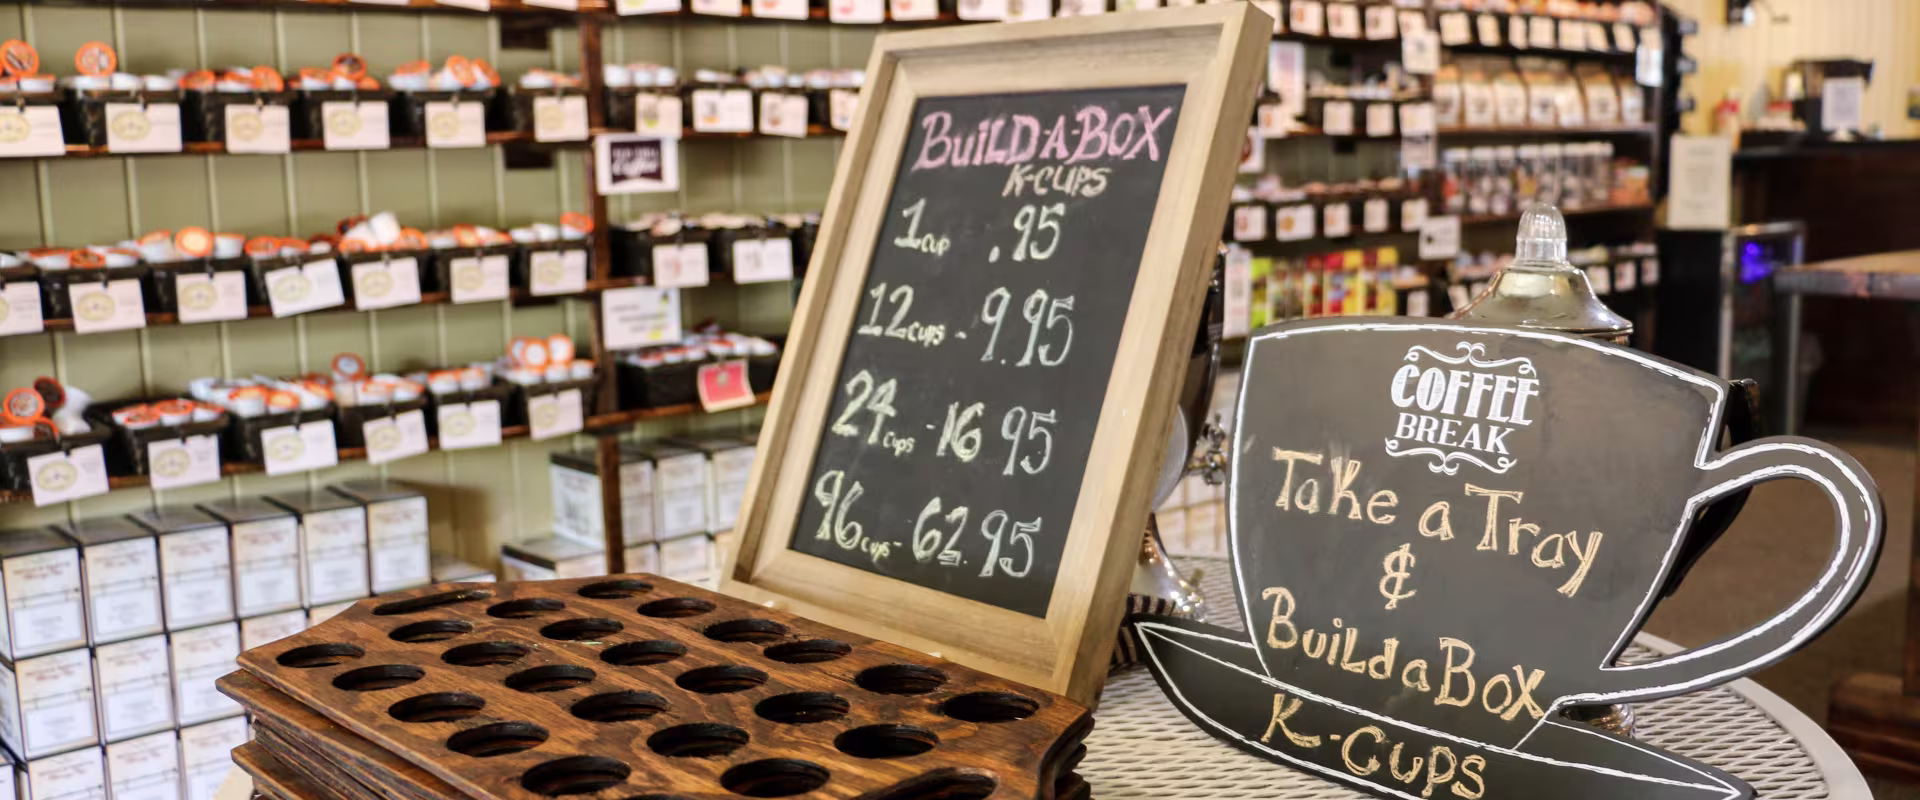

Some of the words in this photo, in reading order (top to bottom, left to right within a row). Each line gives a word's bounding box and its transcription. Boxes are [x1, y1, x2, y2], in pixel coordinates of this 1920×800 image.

[1391, 364, 1540, 426] COFFEE
[1394, 412, 1515, 455] BREAK
[1418, 501, 1454, 540] a
[1465, 483, 1603, 598] Tray
[1379, 543, 1417, 610] &
